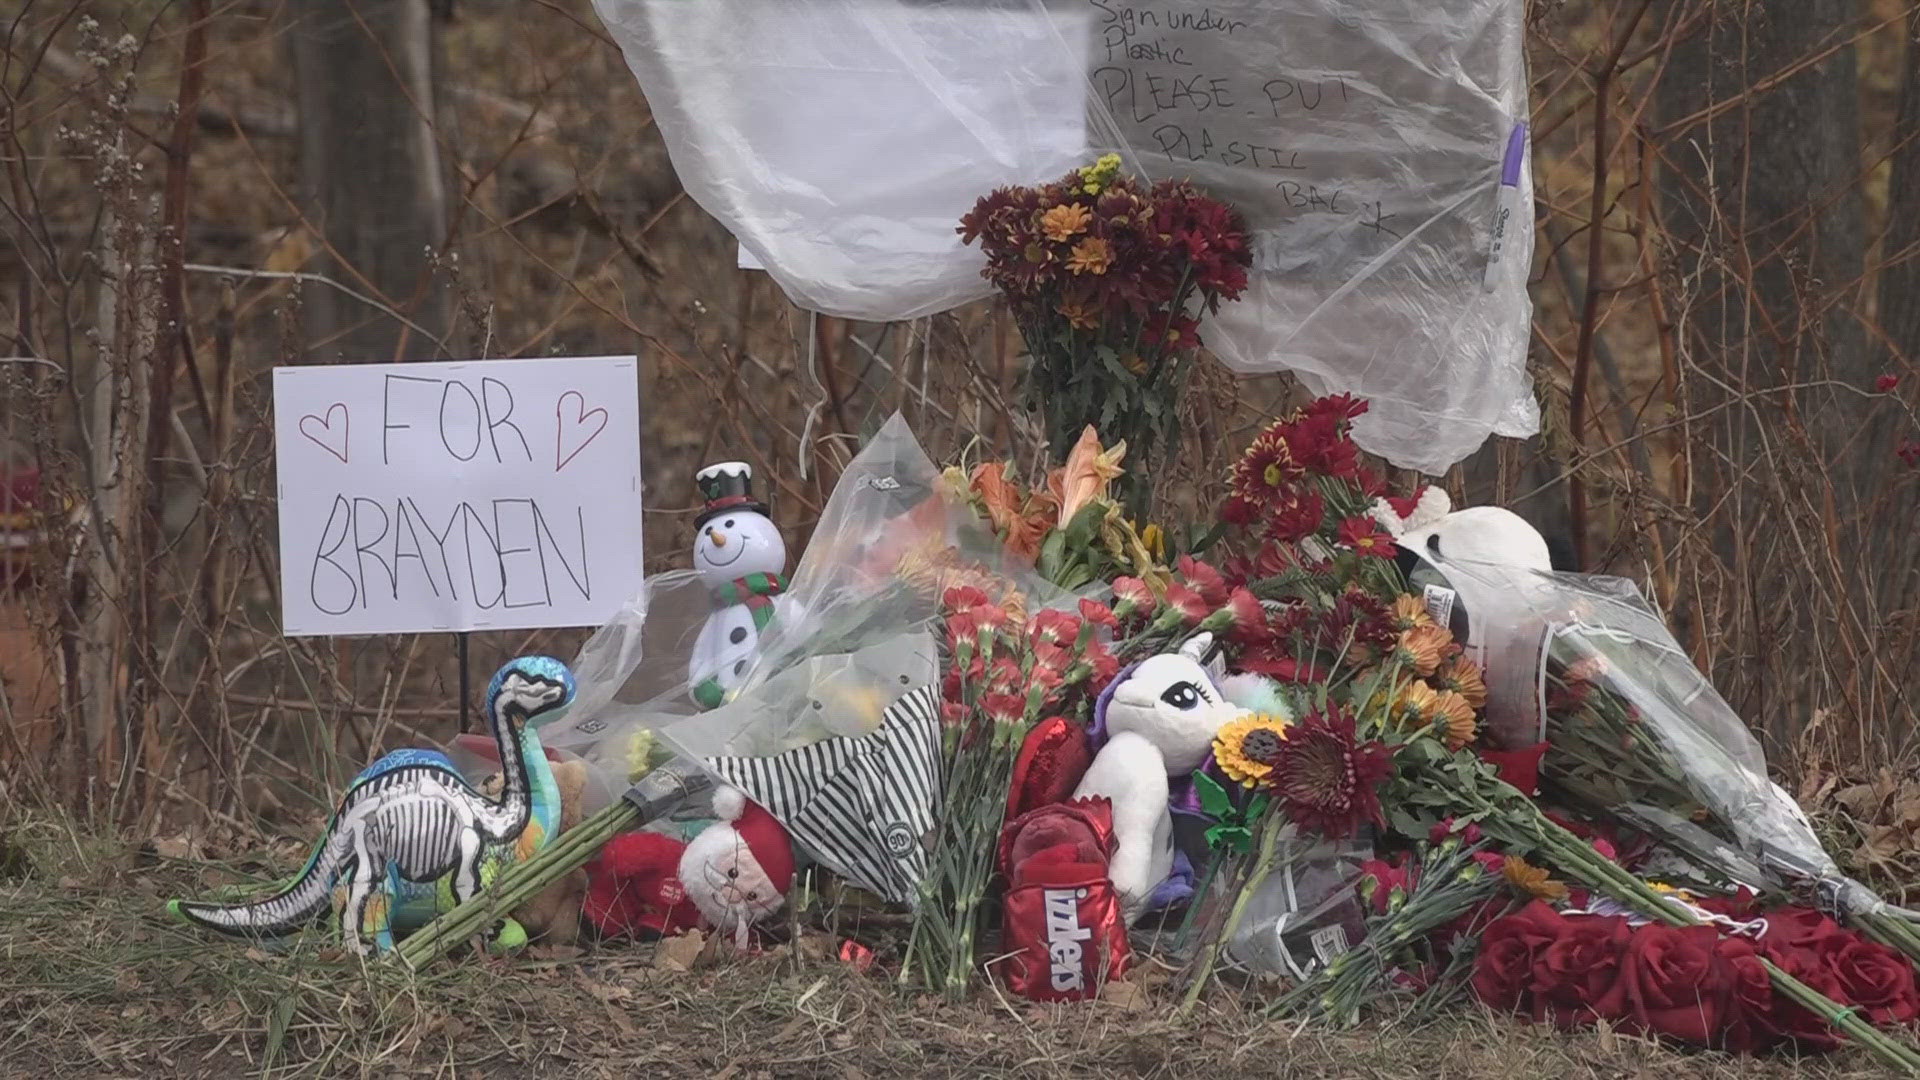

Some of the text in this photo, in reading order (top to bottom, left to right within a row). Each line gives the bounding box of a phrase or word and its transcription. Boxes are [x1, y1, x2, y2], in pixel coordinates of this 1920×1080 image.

[1092, 0, 1247, 36] Sign under
[1103, 25, 1192, 65] Plastic
[1094, 67, 1354, 123] PLEASE PUT
[1153, 124, 1307, 169] PLASTIC
[384, 375, 532, 465] FOR
[311, 494, 590, 614] BRAYDEN
